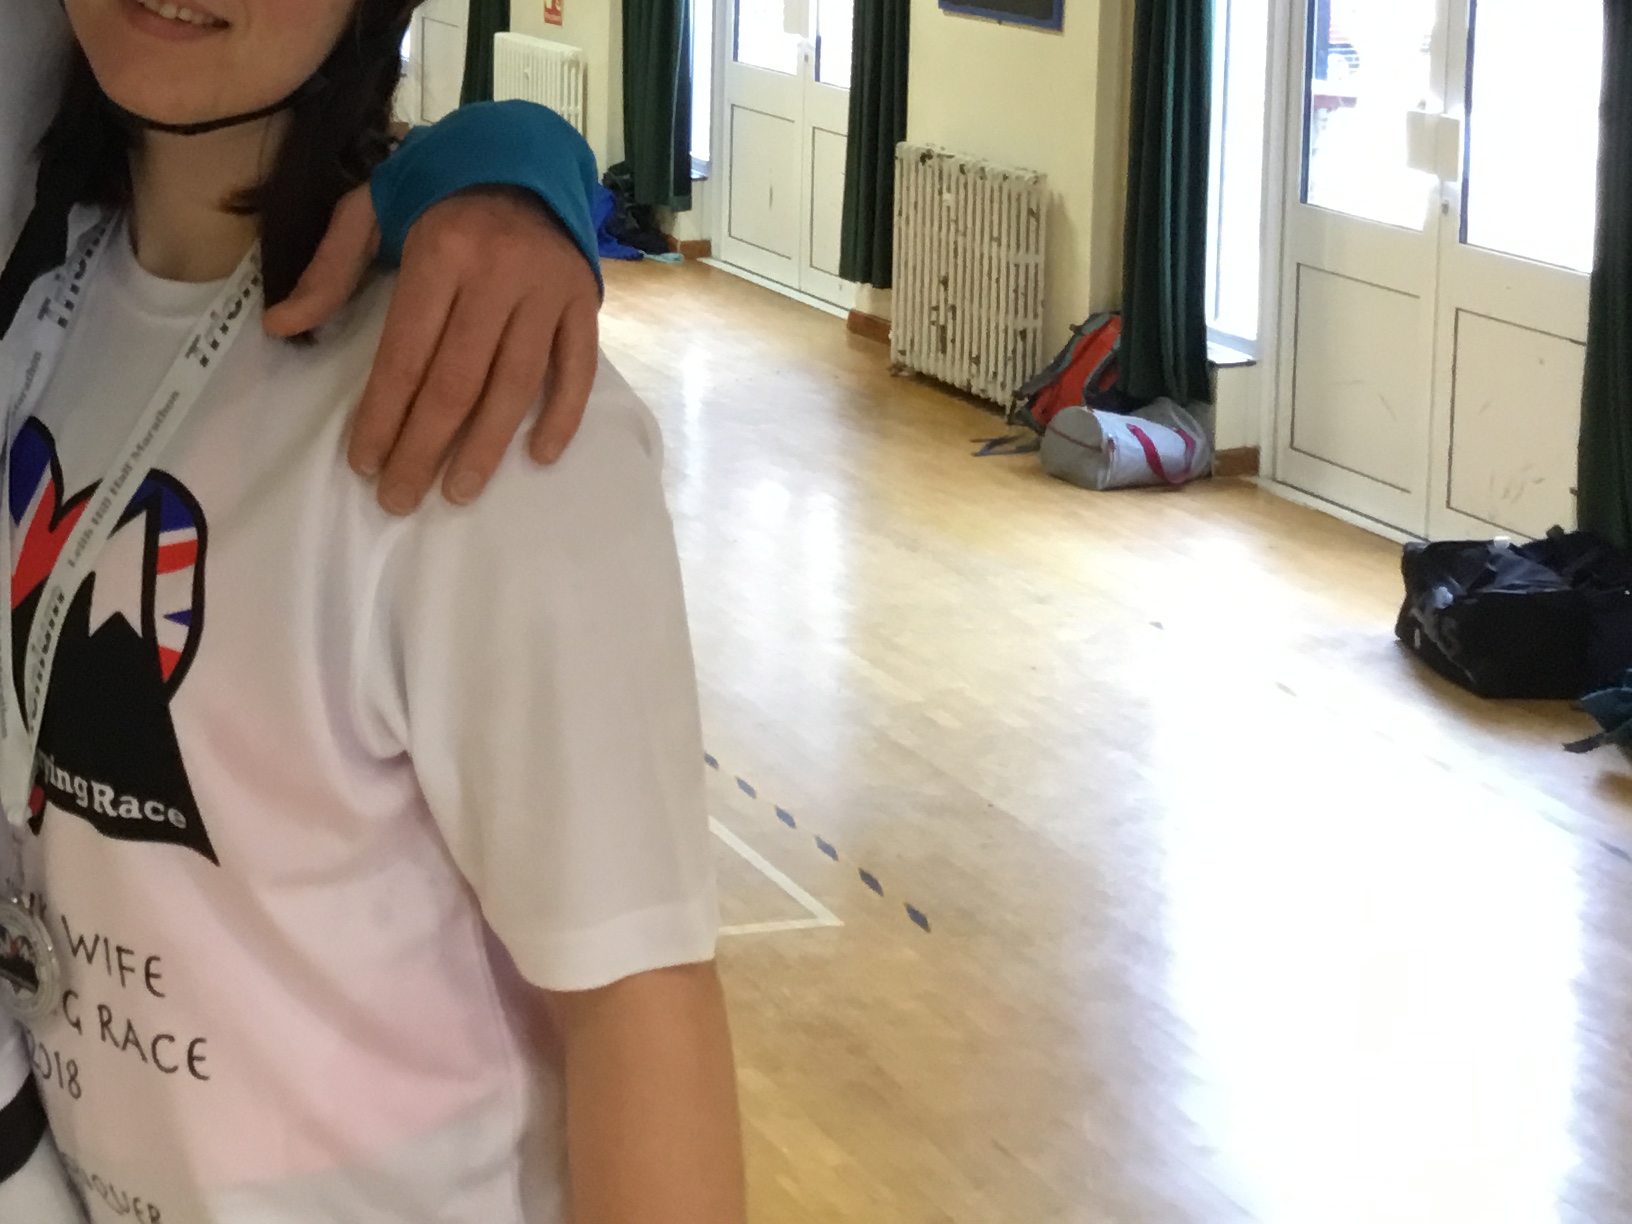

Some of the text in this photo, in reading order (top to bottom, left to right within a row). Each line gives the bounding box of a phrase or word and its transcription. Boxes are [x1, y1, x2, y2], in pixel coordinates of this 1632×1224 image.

[130, 389, 181, 464] Marathon
[61, 914, 167, 999] WIFE
[97, 1003, 211, 1082] RACE
